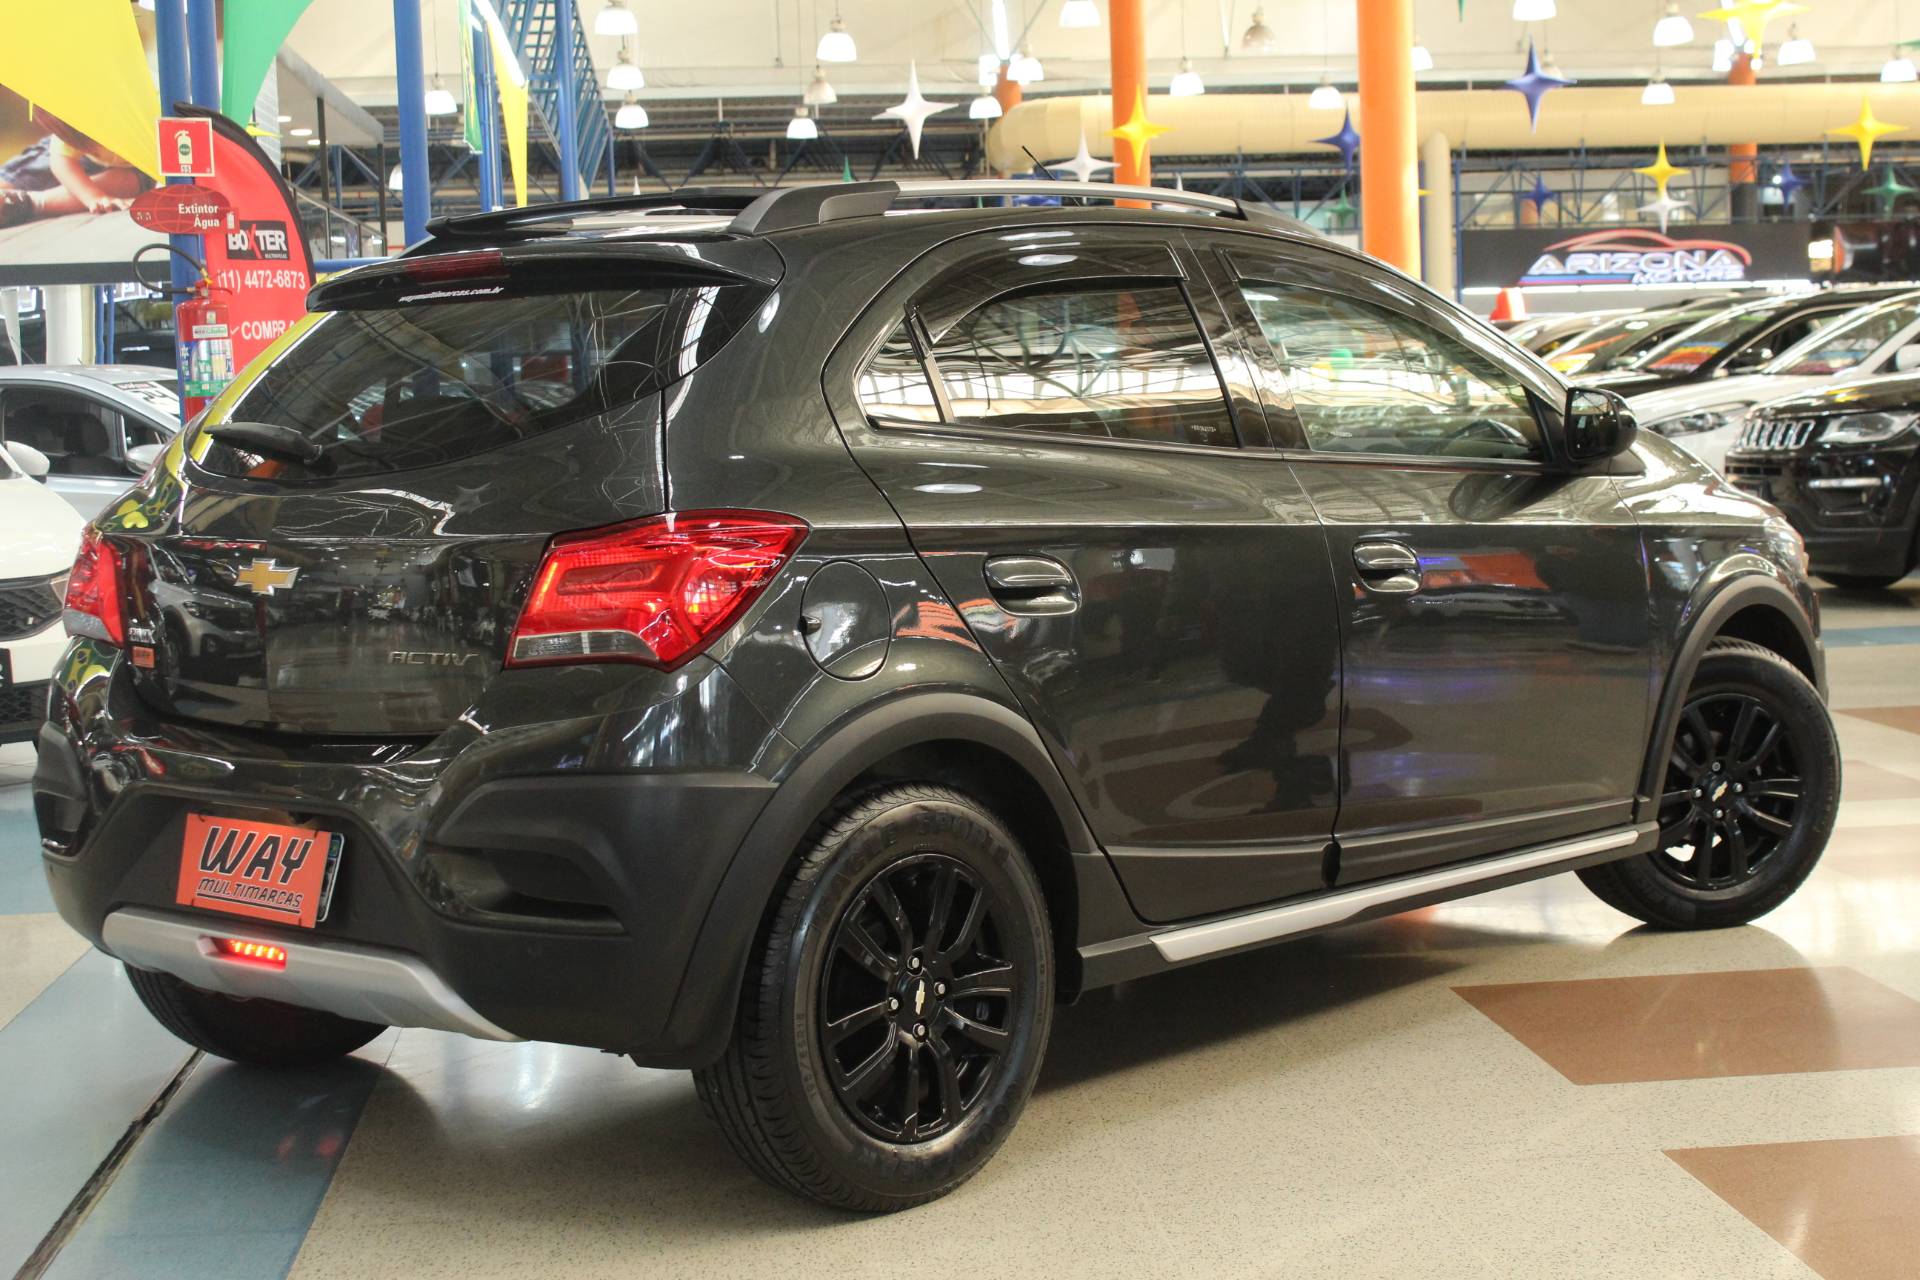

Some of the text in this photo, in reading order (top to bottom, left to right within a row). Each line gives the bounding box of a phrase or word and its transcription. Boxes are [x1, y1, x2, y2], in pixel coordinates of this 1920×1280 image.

[178, 203, 219, 215] Extintor
[193, 214, 220, 229] Água
[227, 224, 287, 258] BOXTER
[1527, 249, 1745, 275] ARIZONA
[217, 269, 306, 293] (11) 4472-6873
[1631, 265, 1745, 285] MOTORS
[388, 651, 479, 666] ACTIV
[198, 826, 314, 886] WAY
[197, 878, 304, 909] MULTIMARCAS
